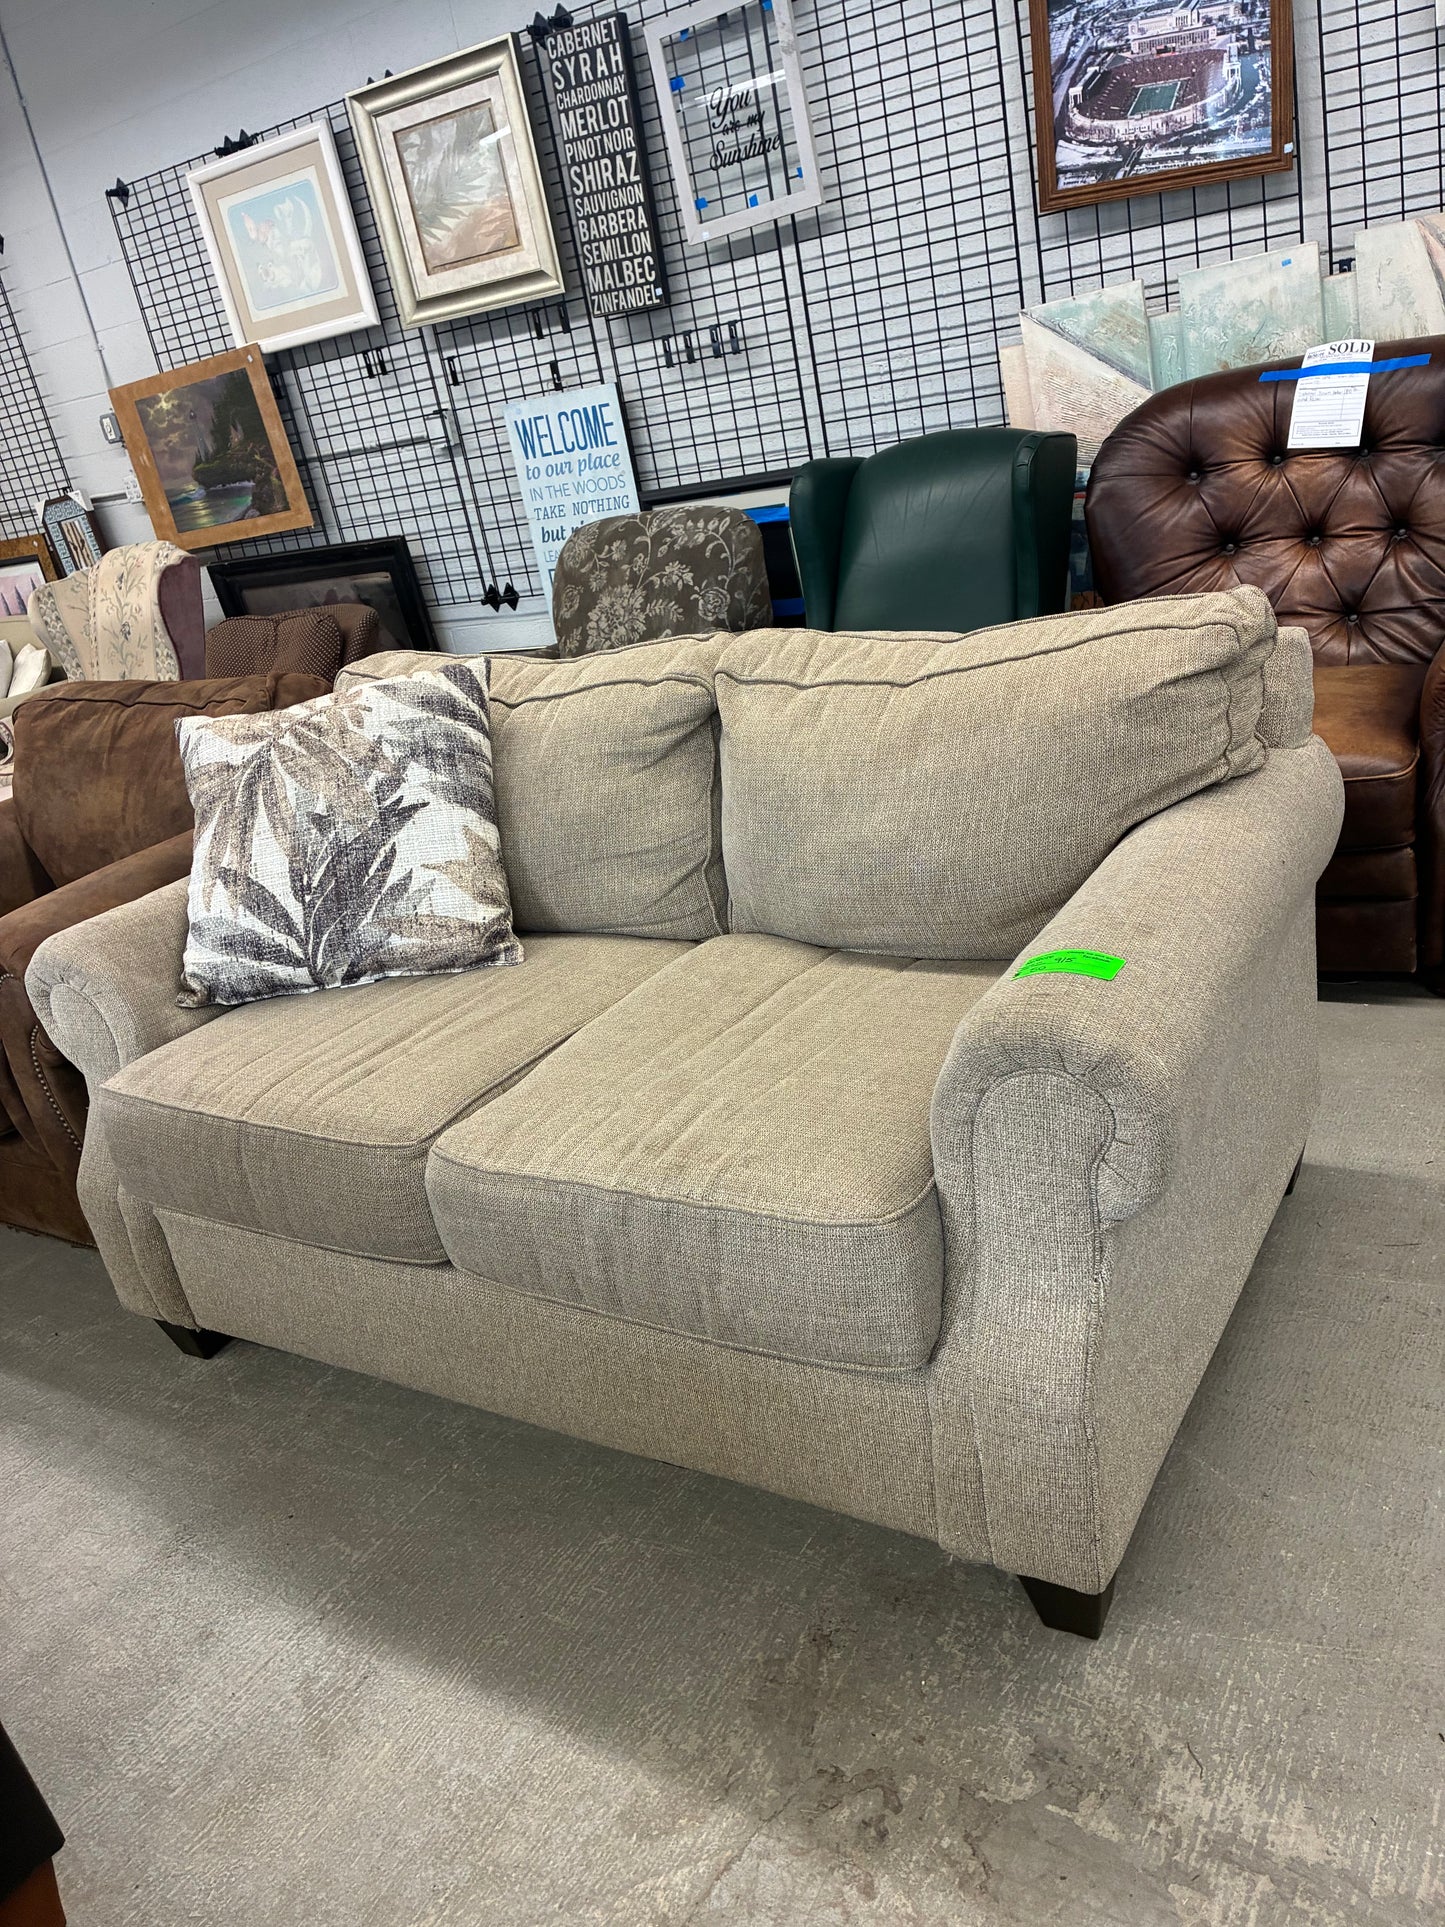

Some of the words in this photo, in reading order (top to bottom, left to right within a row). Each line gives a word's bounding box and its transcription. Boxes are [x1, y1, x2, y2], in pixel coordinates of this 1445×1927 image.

[547, 16, 618, 59] CABERNET
[551, 42, 623, 90] SYRAH
[556, 74, 626, 110] CHARDONNAY
[710, 85, 752, 129] You
[560, 95, 630, 140] MERLOT
[722, 119, 741, 136] are
[747, 110, 765, 132] my
[565, 135, 604, 165] PINOT
[604, 126, 635, 154] NOIR
[710, 133, 781, 171] Sunshine
[570, 151, 641, 196] SHIRAZ
[575, 183, 644, 217] SAUVIGNON
[578, 206, 648, 242] BARBERA
[583, 230, 652, 265] SEMILLON
[587, 255, 656, 294] MALBEC
[591, 284, 660, 315] ZINFANDEL
[1329, 341, 1371, 354] SOLD
[514, 403, 618, 460] WELCOME
[526, 464, 541, 481] to
[545, 460, 573, 477] our
[577, 452, 621, 476] place
[529, 487, 544, 502] IN
[545, 482, 572, 499] THE
[571, 474, 626, 495] WOODS
[534, 504, 566, 521] TAKE
[572, 495, 630, 516] NOTHING
[541, 524, 567, 544] but
